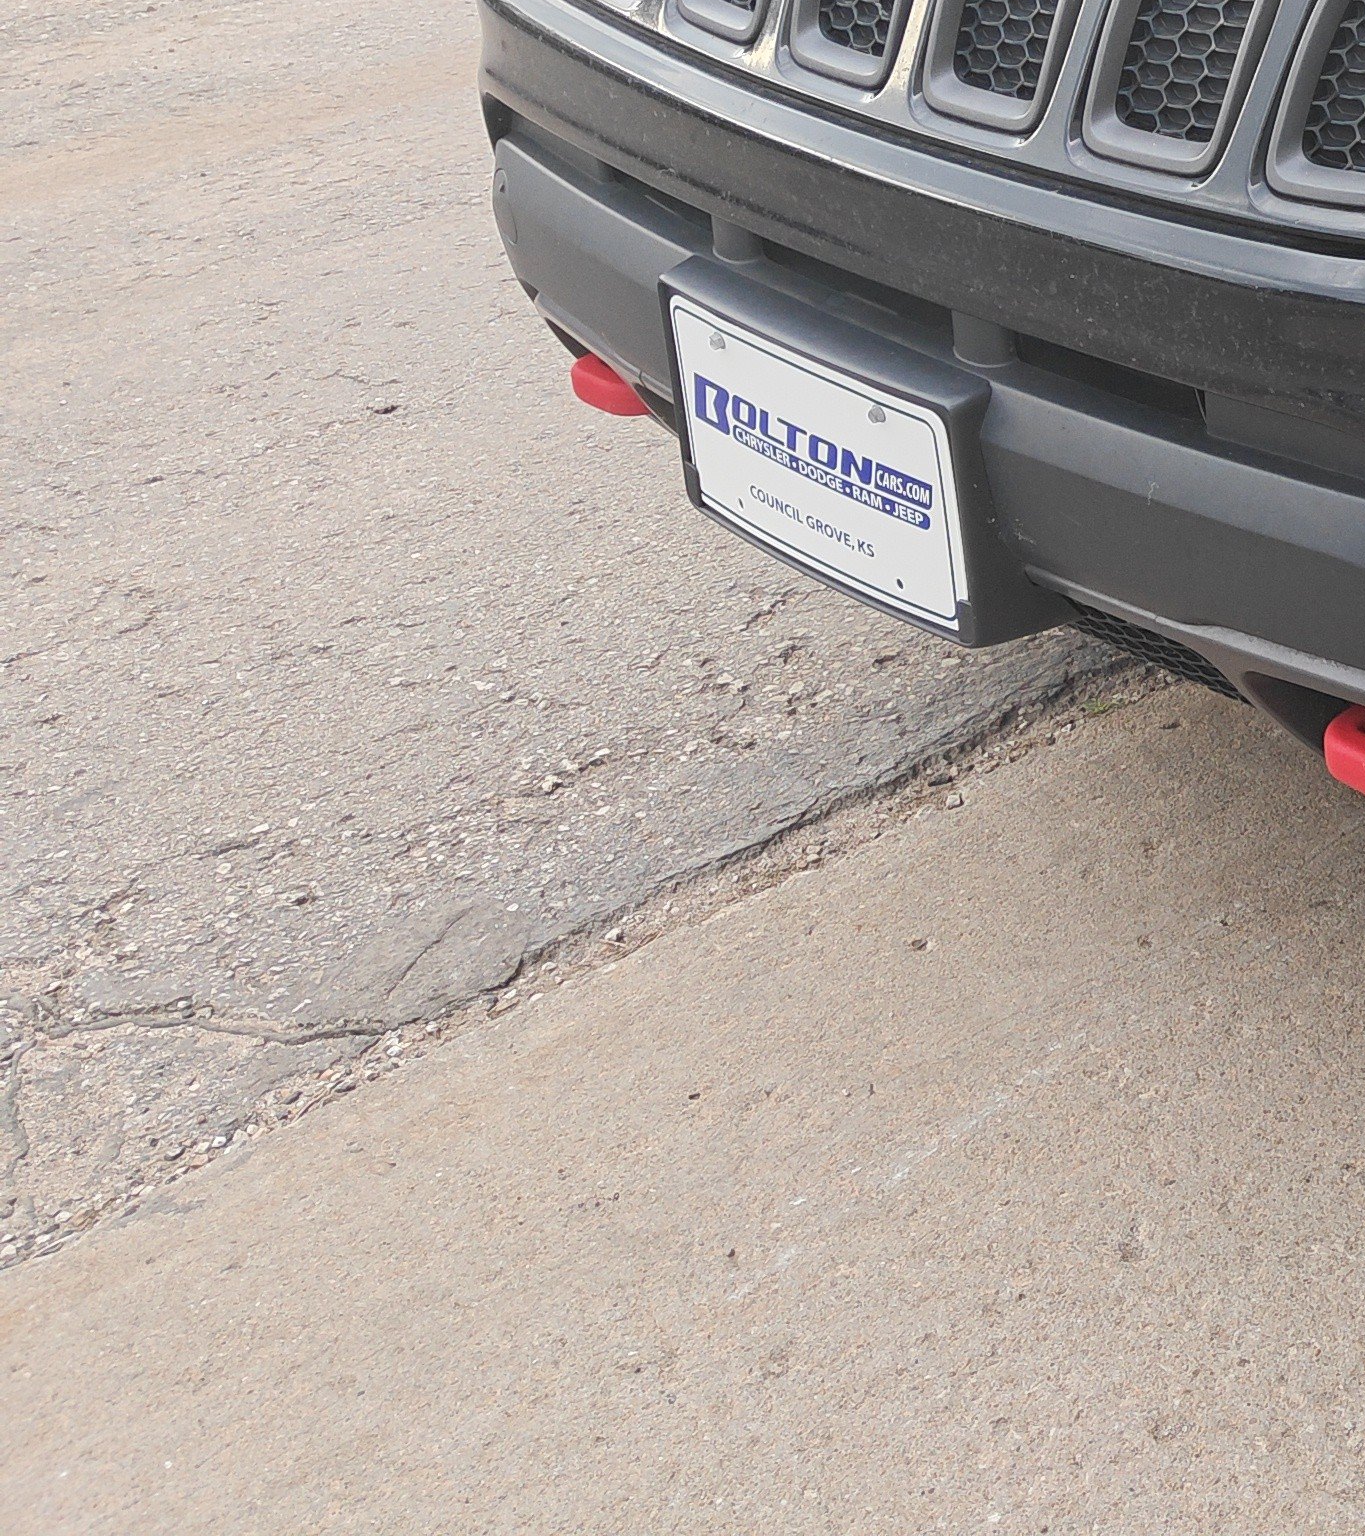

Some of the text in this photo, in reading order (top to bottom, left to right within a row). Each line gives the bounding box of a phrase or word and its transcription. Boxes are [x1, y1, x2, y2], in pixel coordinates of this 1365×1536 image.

[693, 372, 930, 506] BOLTON CARS.COM
[734, 427, 924, 526] CHRYSLER DODGE RAM JEEP
[749, 484, 875, 558] COUNCIL GROVE, KS
